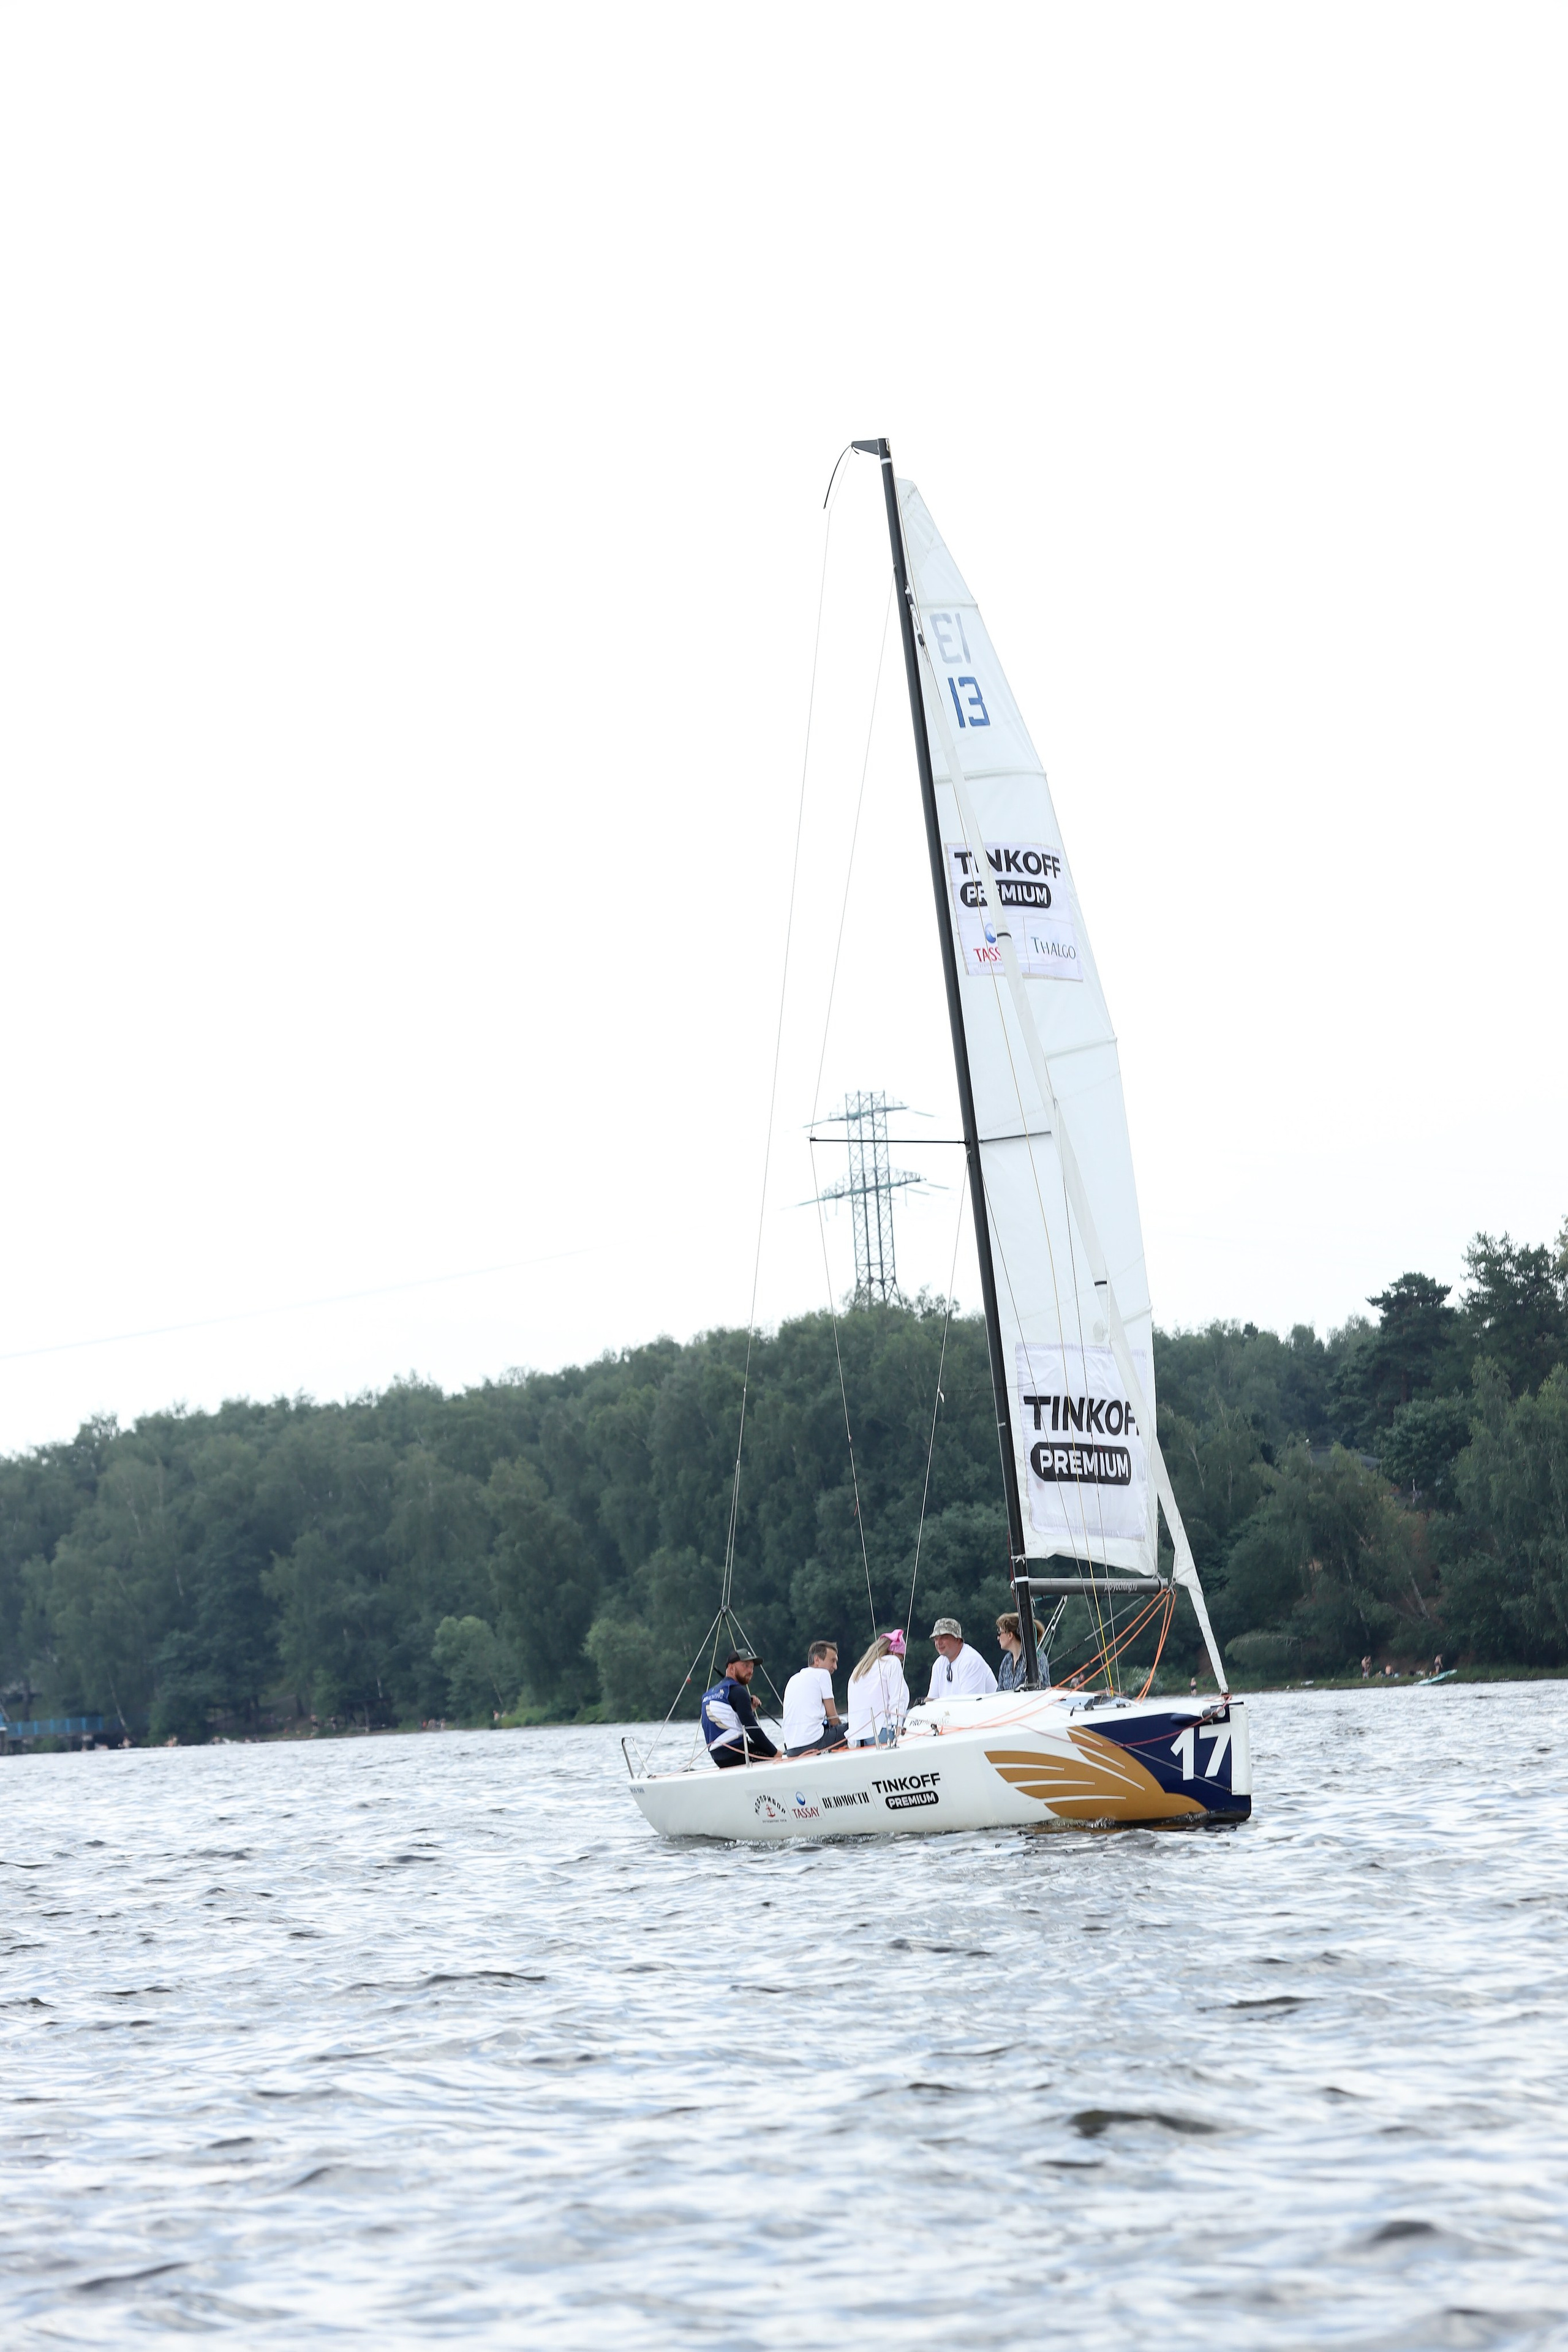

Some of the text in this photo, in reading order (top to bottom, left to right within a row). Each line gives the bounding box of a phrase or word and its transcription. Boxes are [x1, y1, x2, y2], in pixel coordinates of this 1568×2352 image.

[948, 676, 991, 728] 13
[967, 883, 1048, 905] PRMIUM
[973, 946, 1002, 963] TASS
[1030, 936, 1076, 960] THALGO
[1023, 1395, 1140, 1436] TINKOF
[1039, 1448, 1129, 1479] PREMIUM
[1170, 1722, 1232, 1781] 17
[872, 1772, 941, 1794] TINKOFF
[791, 1806, 820, 1819] TASSAY
[888, 1793, 936, 1809] PREMIUM
